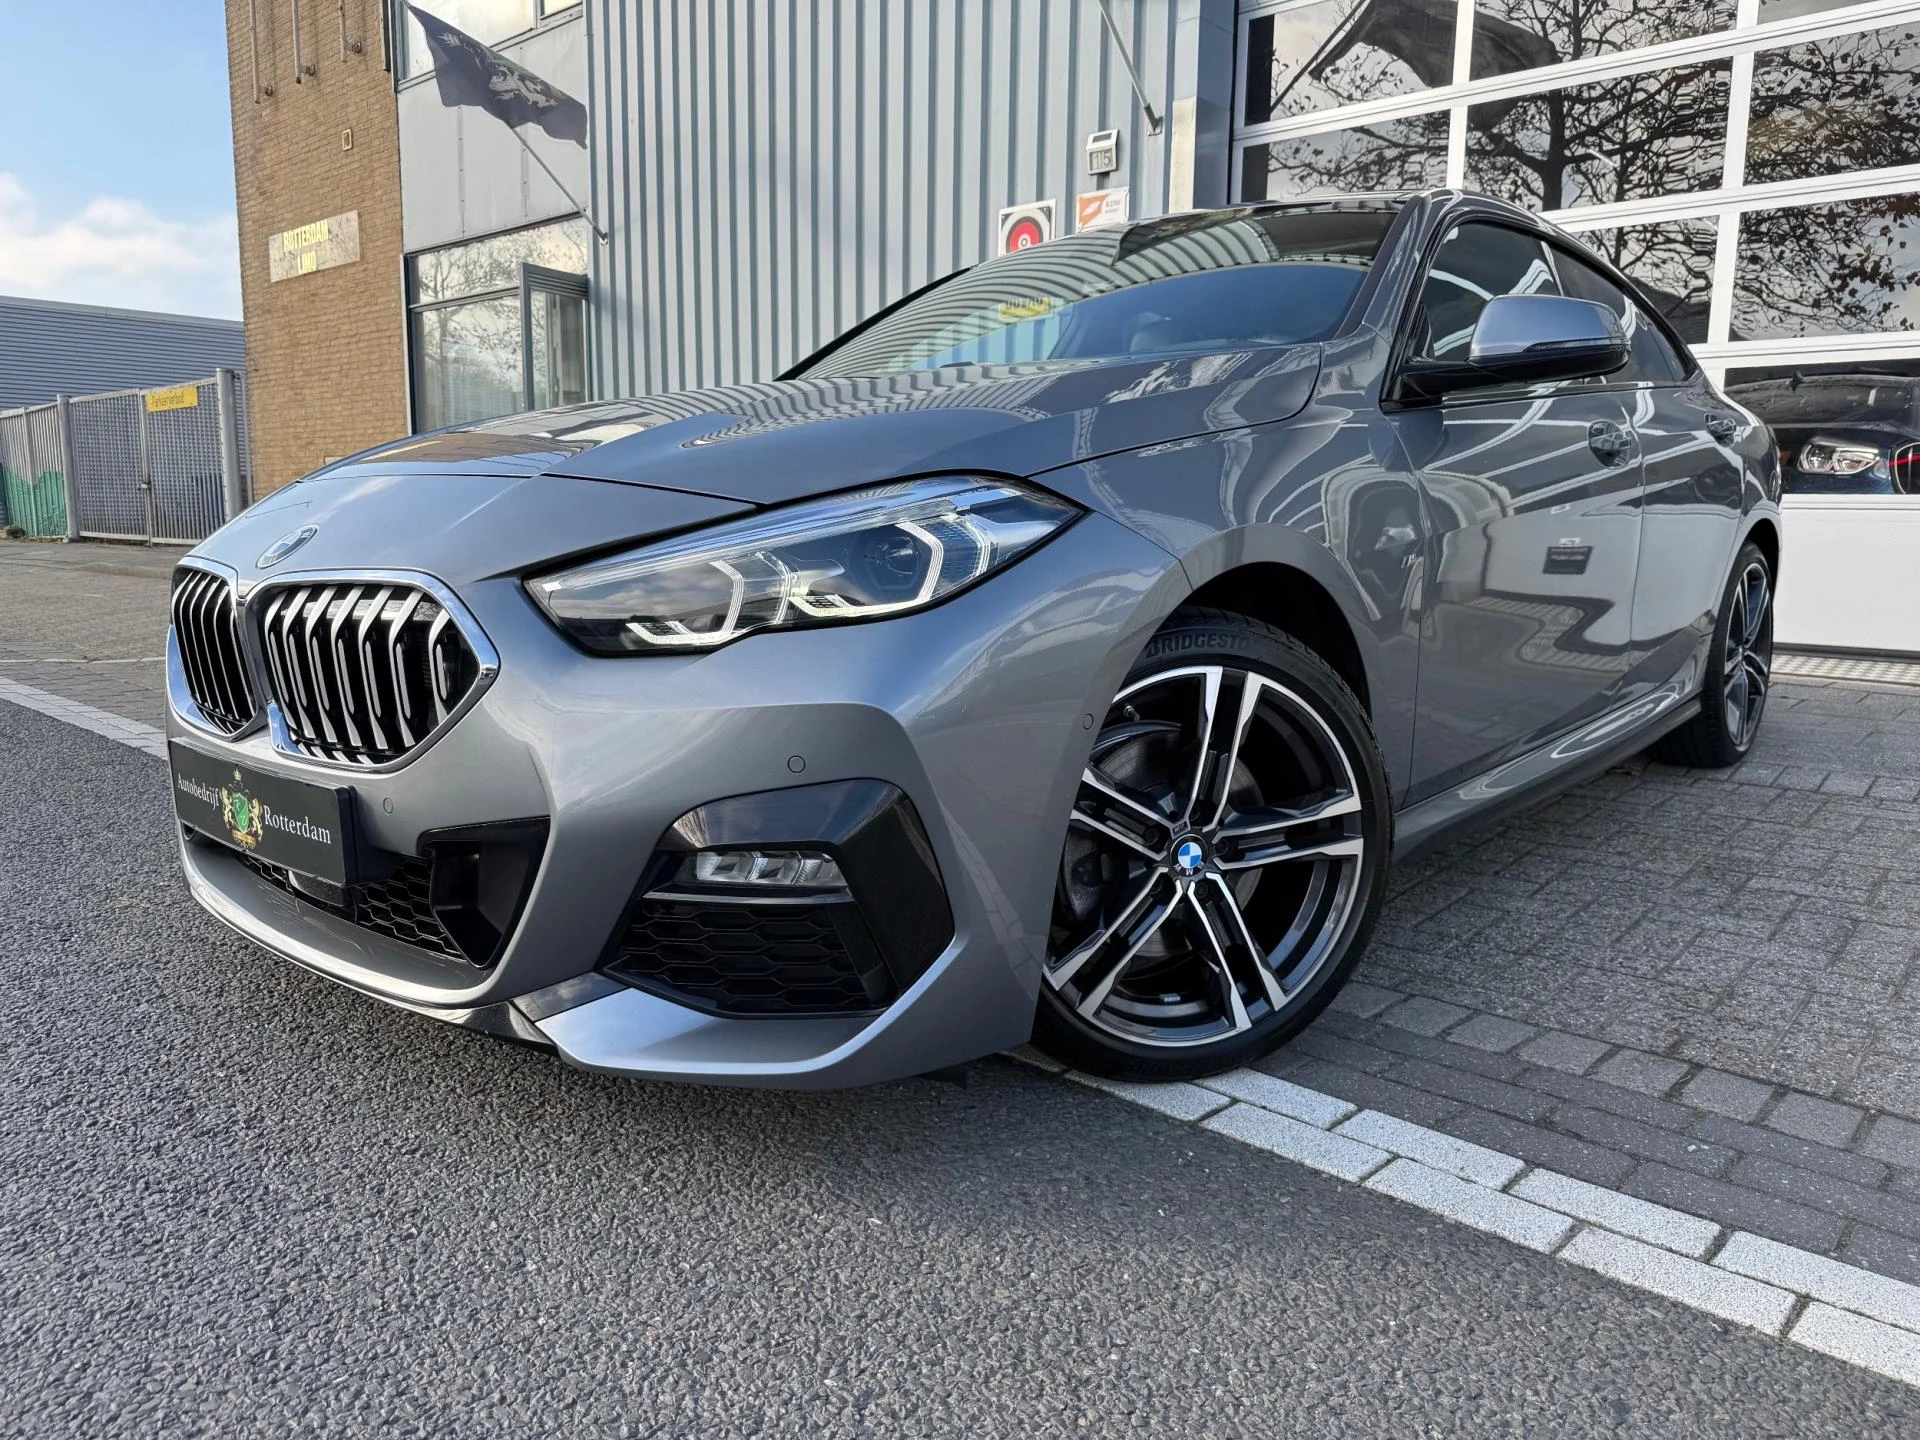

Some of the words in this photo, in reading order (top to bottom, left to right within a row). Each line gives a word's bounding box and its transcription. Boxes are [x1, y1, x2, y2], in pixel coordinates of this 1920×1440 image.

[1094, 151, 1111, 169] 15
[283, 219, 329, 253] ROTTERDAM
[298, 251, 317, 275] LIMO
[1144, 631, 1250, 659] BRIDGESTO
[177, 772, 219, 811] Autobedrijf
[263, 804, 332, 844] Rotterdam
